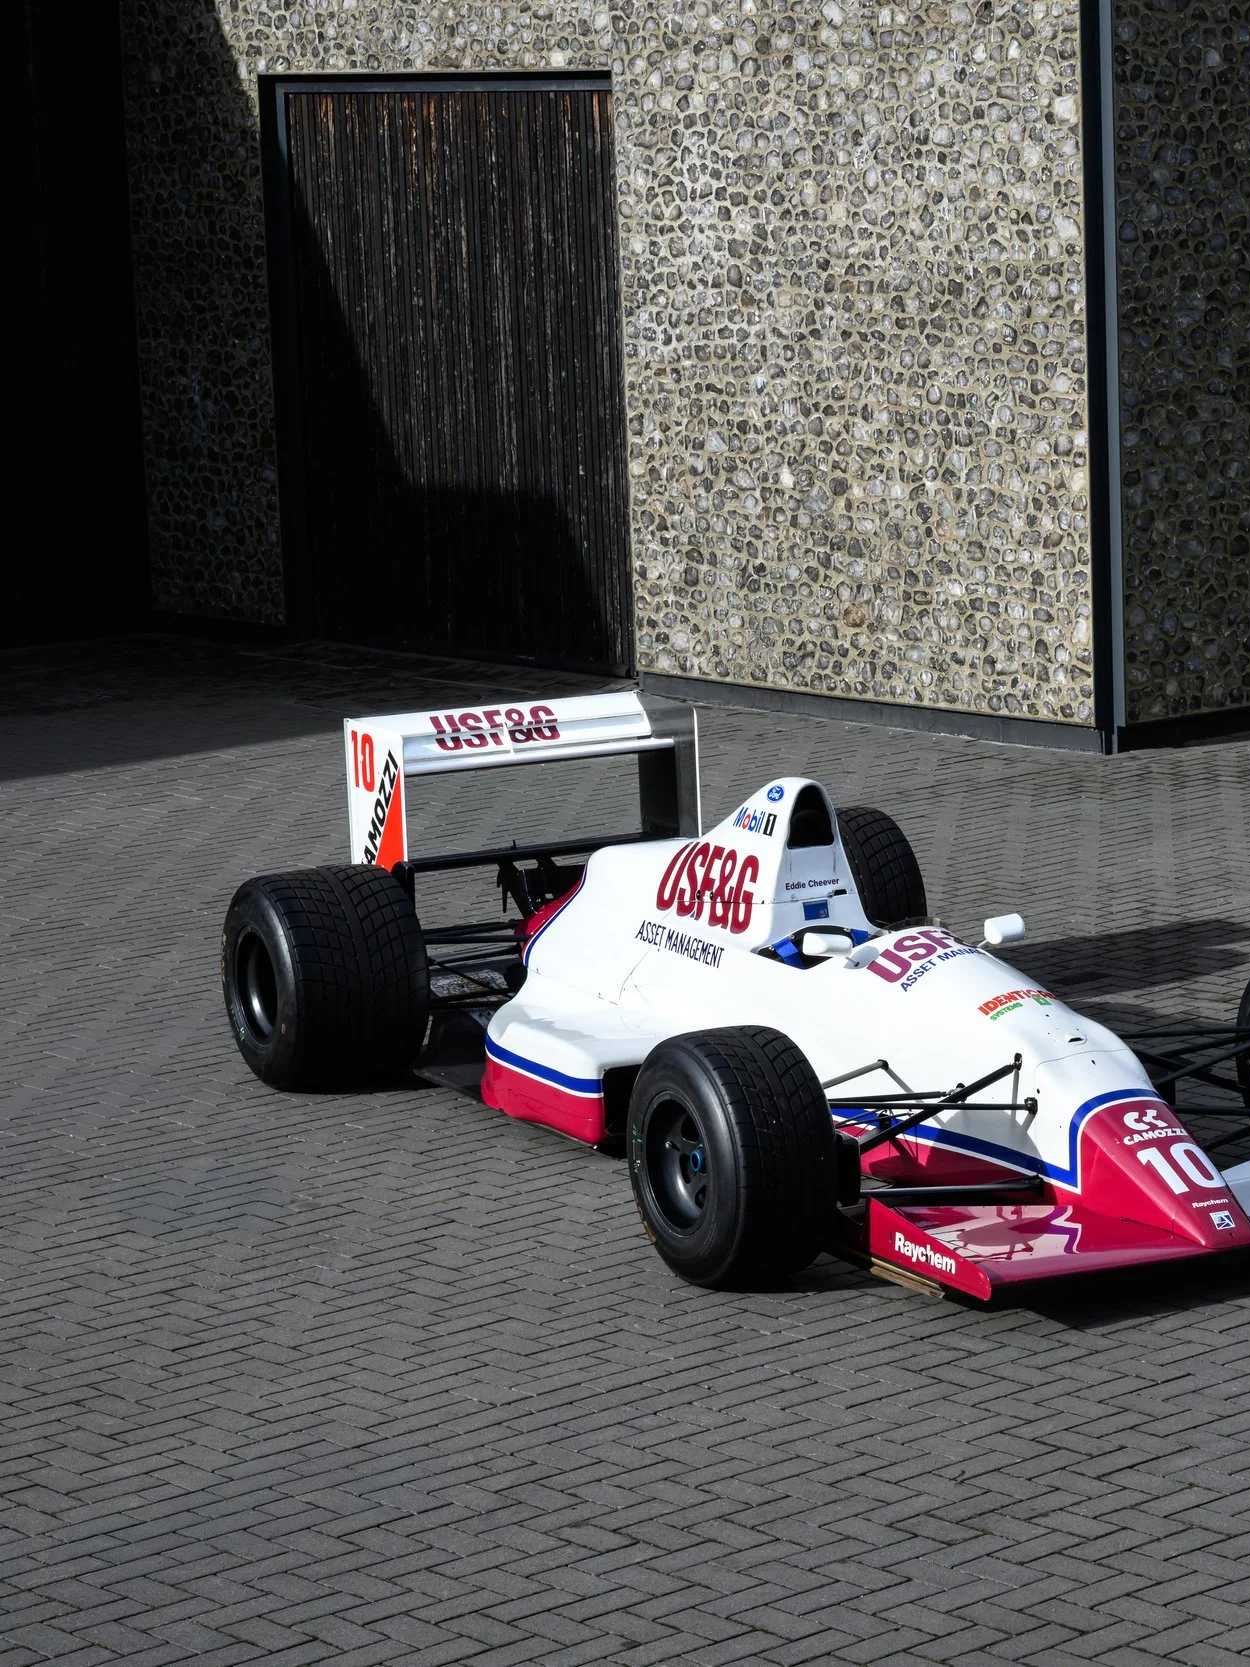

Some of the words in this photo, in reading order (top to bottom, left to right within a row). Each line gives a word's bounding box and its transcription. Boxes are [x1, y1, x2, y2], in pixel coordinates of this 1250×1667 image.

[429, 705, 561, 751] USF&G
[351, 729, 375, 793] 10
[361, 749, 399, 865] AMOZZI
[732, 806, 766, 833] Mobil
[655, 841, 760, 934] USF&G
[785, 881, 808, 891] Eddie
[808, 877, 840, 889] Cheever
[635, 919, 666, 947] ASSET
[665, 928, 725, 969] MANAGEMENT
[900, 958, 937, 992] ASSET
[989, 1002, 1023, 1021] SYSTEMS
[1136, 1142, 1227, 1195] 10
[1192, 1198, 1229, 1208] Raychem
[894, 1231, 956, 1275] Raychem
